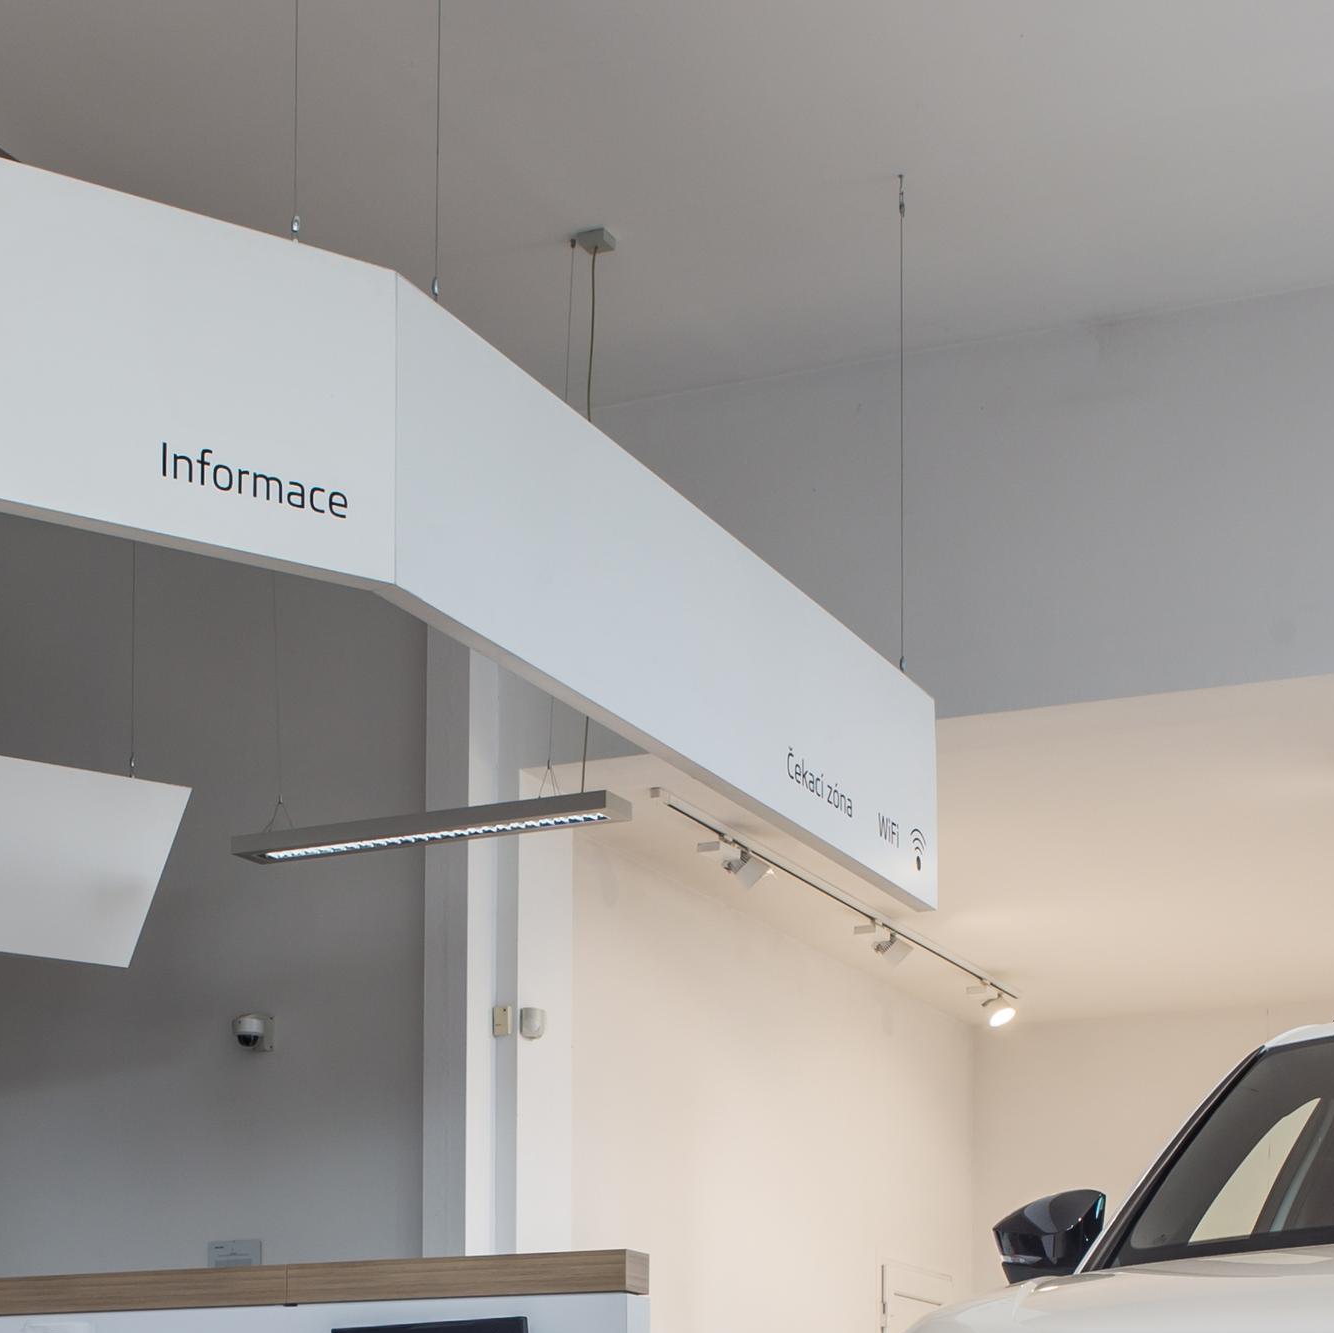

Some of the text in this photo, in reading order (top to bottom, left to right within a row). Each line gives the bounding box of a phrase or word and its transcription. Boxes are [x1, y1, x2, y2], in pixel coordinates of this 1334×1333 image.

[162, 442, 348, 519] Informace
[787, 746, 853, 818] Čekací zóna
[878, 812, 899, 848] WiFi
